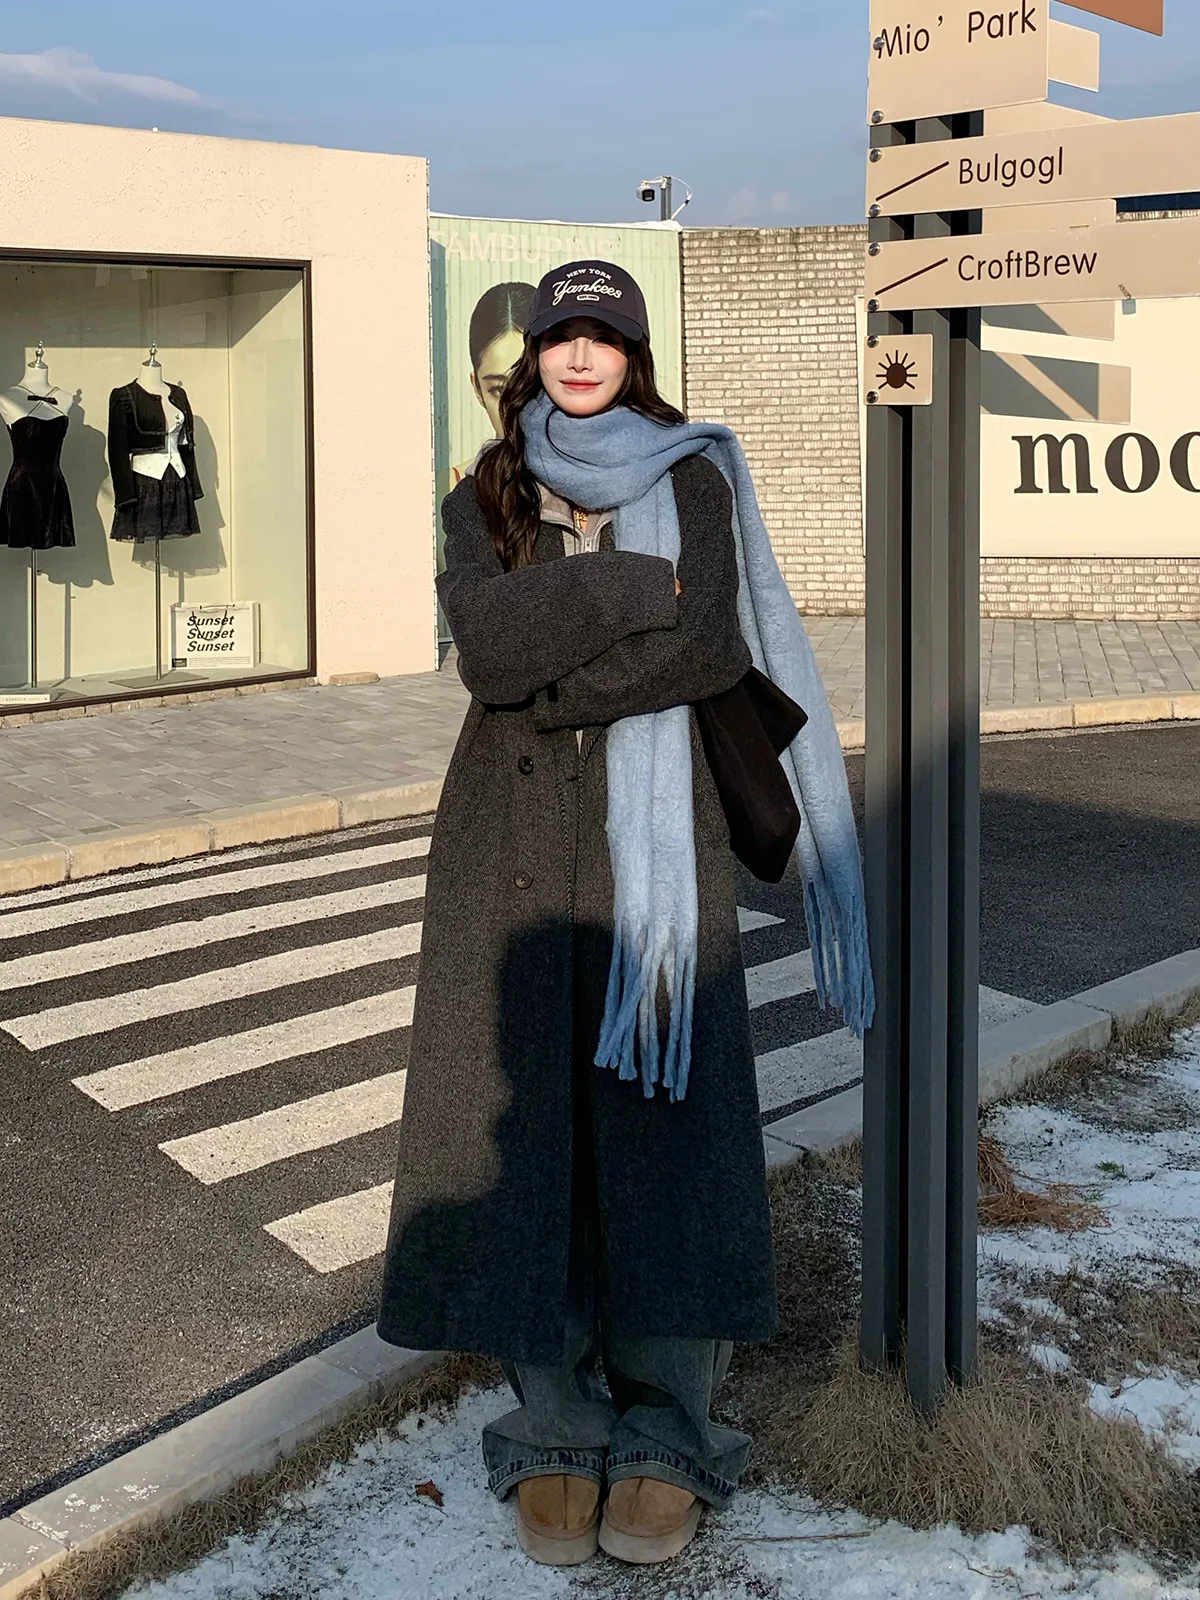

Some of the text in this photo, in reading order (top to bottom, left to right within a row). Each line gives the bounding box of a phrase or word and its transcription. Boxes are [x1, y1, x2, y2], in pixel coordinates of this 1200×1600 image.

[967, 0, 1037, 43] Park
[958, 250, 1098, 281] CroftBrew
[566, 268, 612, 280] NEW YORK
[552, 278, 622, 306] Yankees
[187, 615, 235, 627] Sunset
[187, 628, 235, 640] Sunset
[187, 641, 235, 652] Sunset
